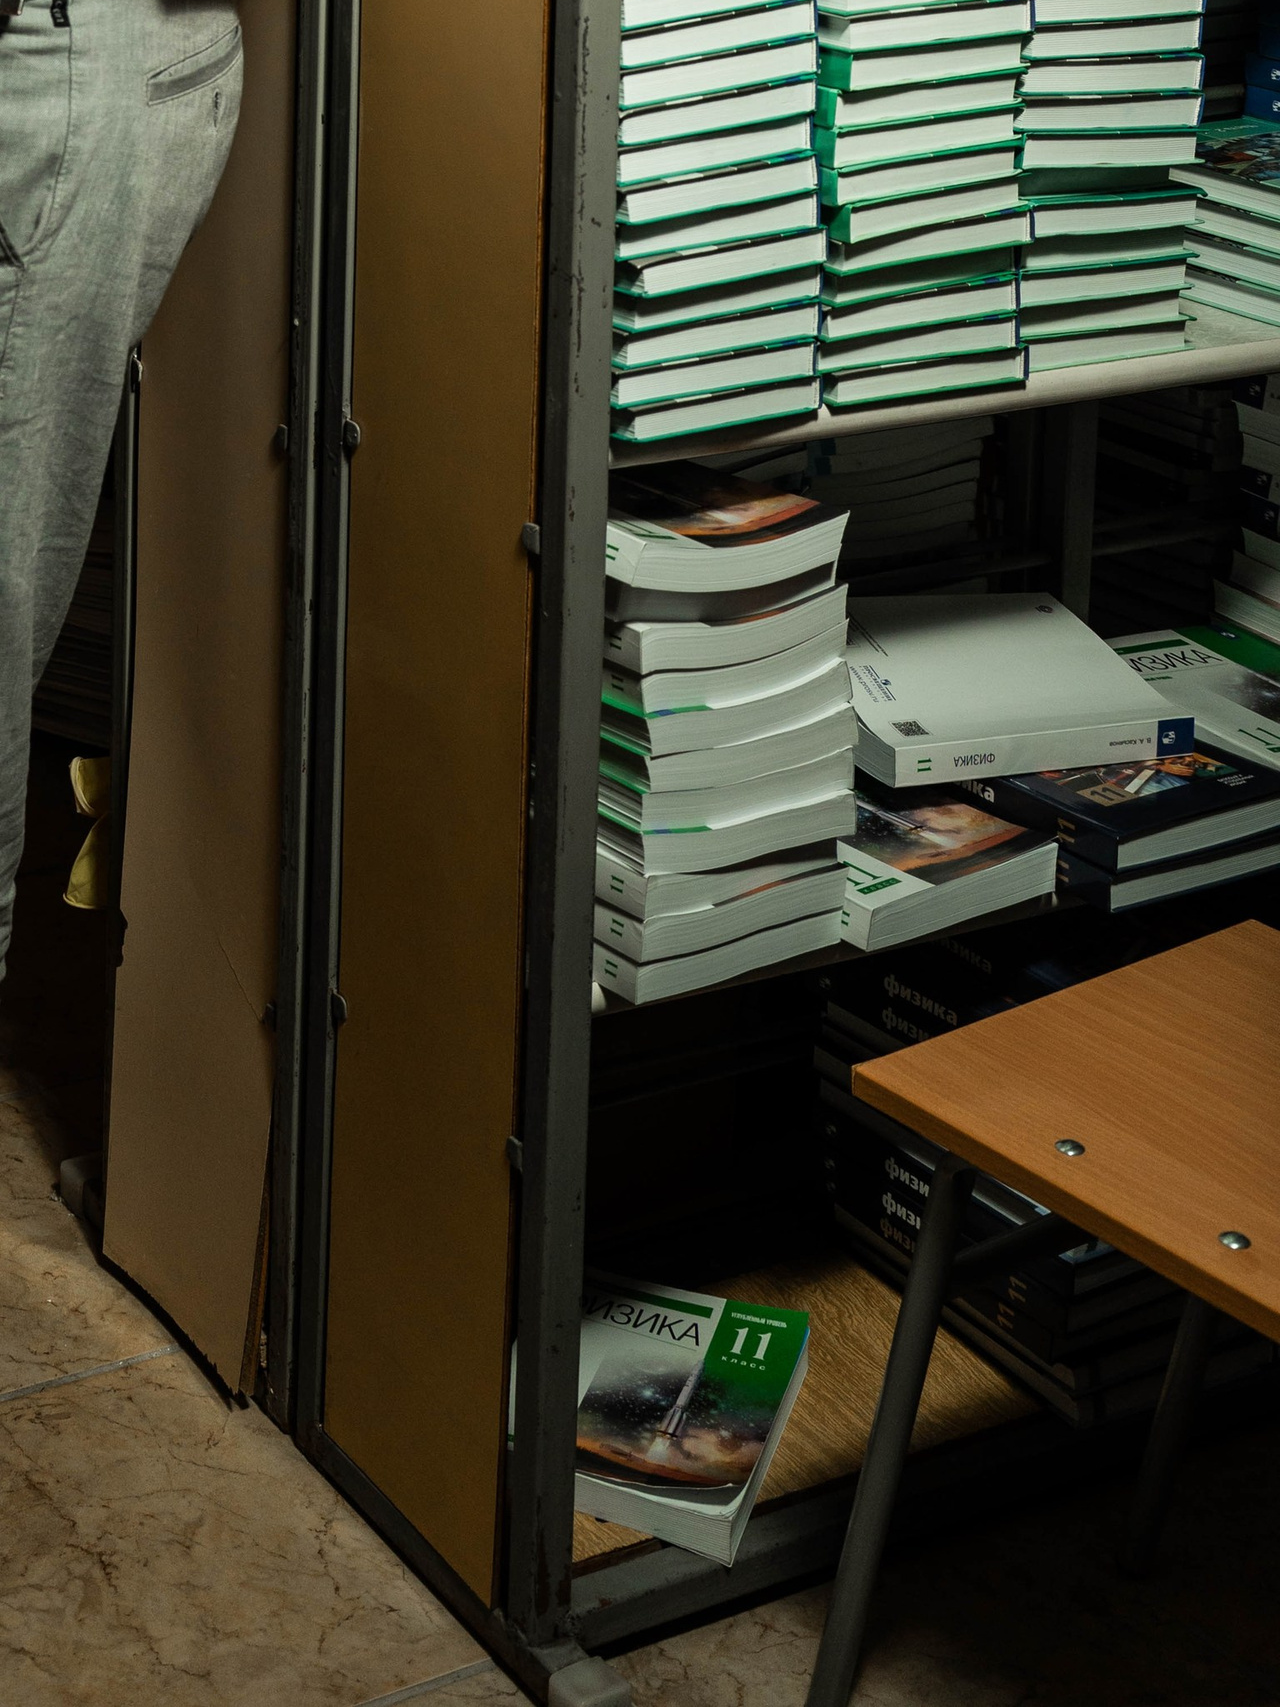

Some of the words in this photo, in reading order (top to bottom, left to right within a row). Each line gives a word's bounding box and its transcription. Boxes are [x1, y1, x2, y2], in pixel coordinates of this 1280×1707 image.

[917, 757, 932, 773] 11
[953, 752, 996, 768] ФИЗИКА
[1090, 787, 1126, 802] 11
[1057, 816, 1076, 843] 11
[610, 874, 625, 894] 11
[609, 917, 625, 937] 11
[604, 959, 619, 978] 11
[883, 974, 958, 1026] физика
[1008, 1275, 1028, 1304] 11
[582, 1295, 700, 1346] ИЗИКА
[996, 1302, 1016, 1330] 11
[730, 1327, 772, 1361] 11
[721, 1356, 766, 1371] класс
